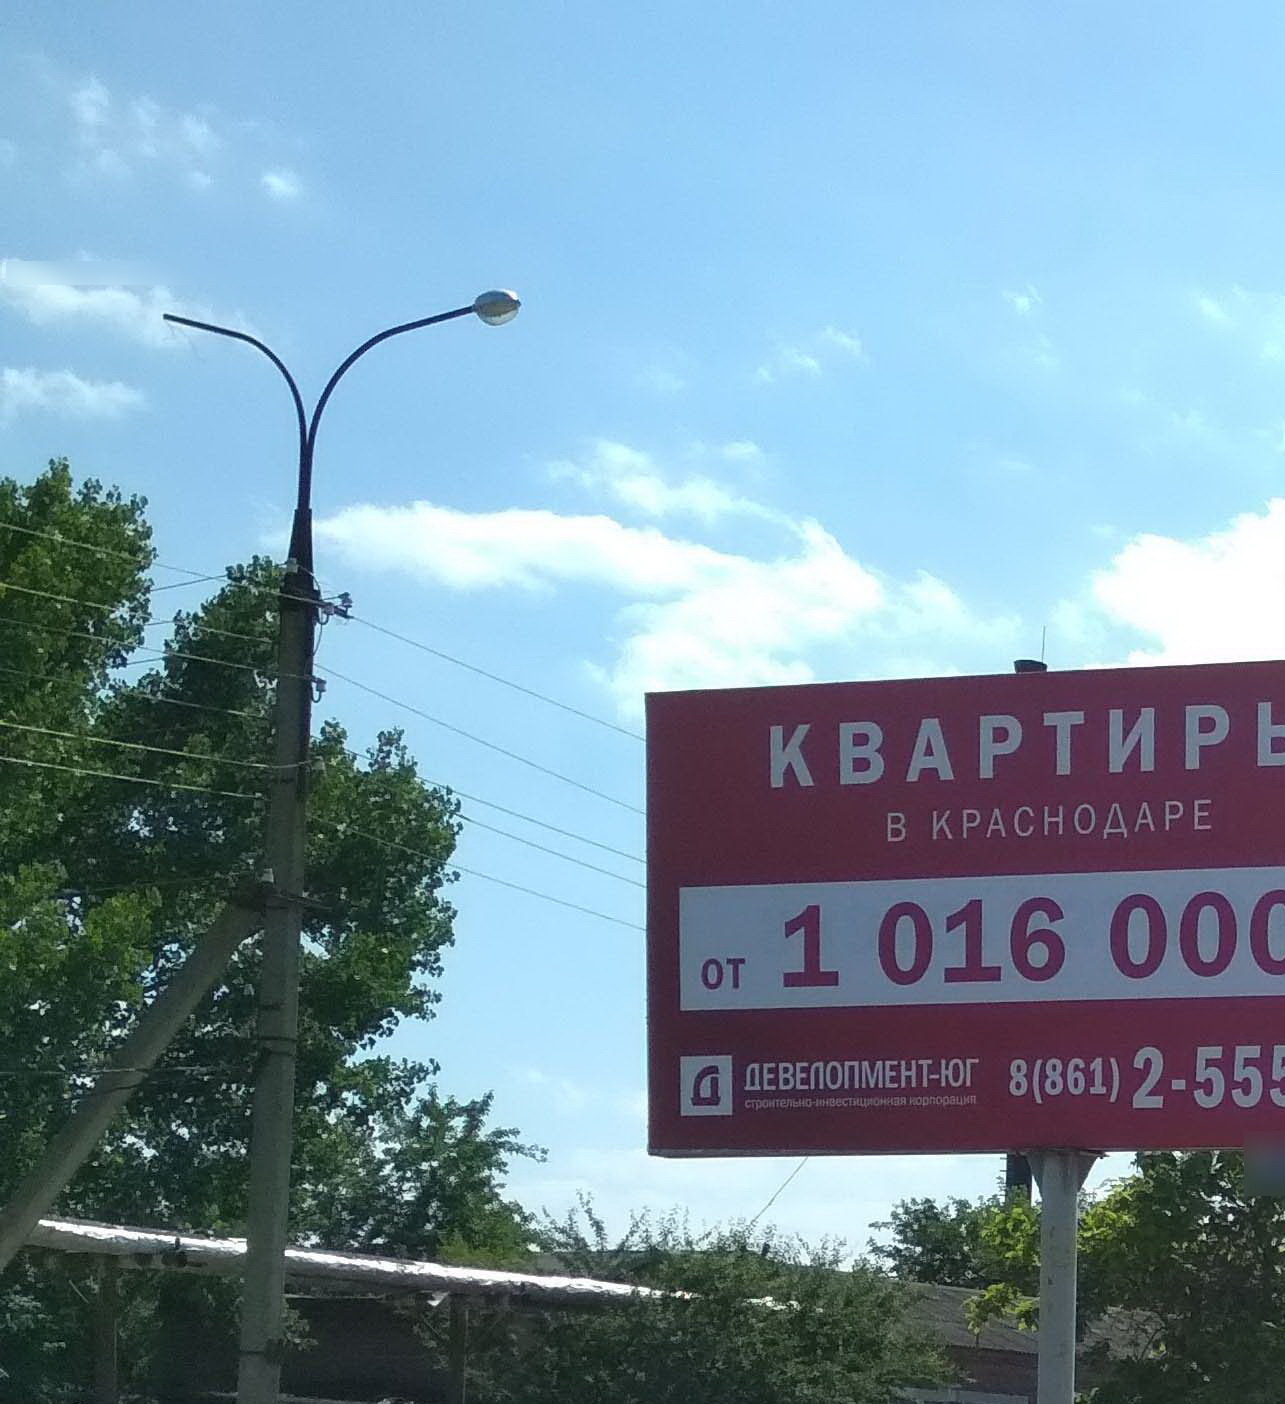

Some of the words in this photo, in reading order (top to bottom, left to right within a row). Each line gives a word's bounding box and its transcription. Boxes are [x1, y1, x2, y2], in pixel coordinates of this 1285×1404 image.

[886, 811, 908, 843] В
[931, 799, 1213, 840] КРАСНОДАРЕ
[700, 957, 746, 991] ОТ
[782, 904, 840, 988] 1
[877, 896, 1067, 987] 016
[743, 1057, 980, 1092] ДЕВЕЛОПМЕНТ-ЮГ
[1007, 1056, 1122, 1104] 8(861)
